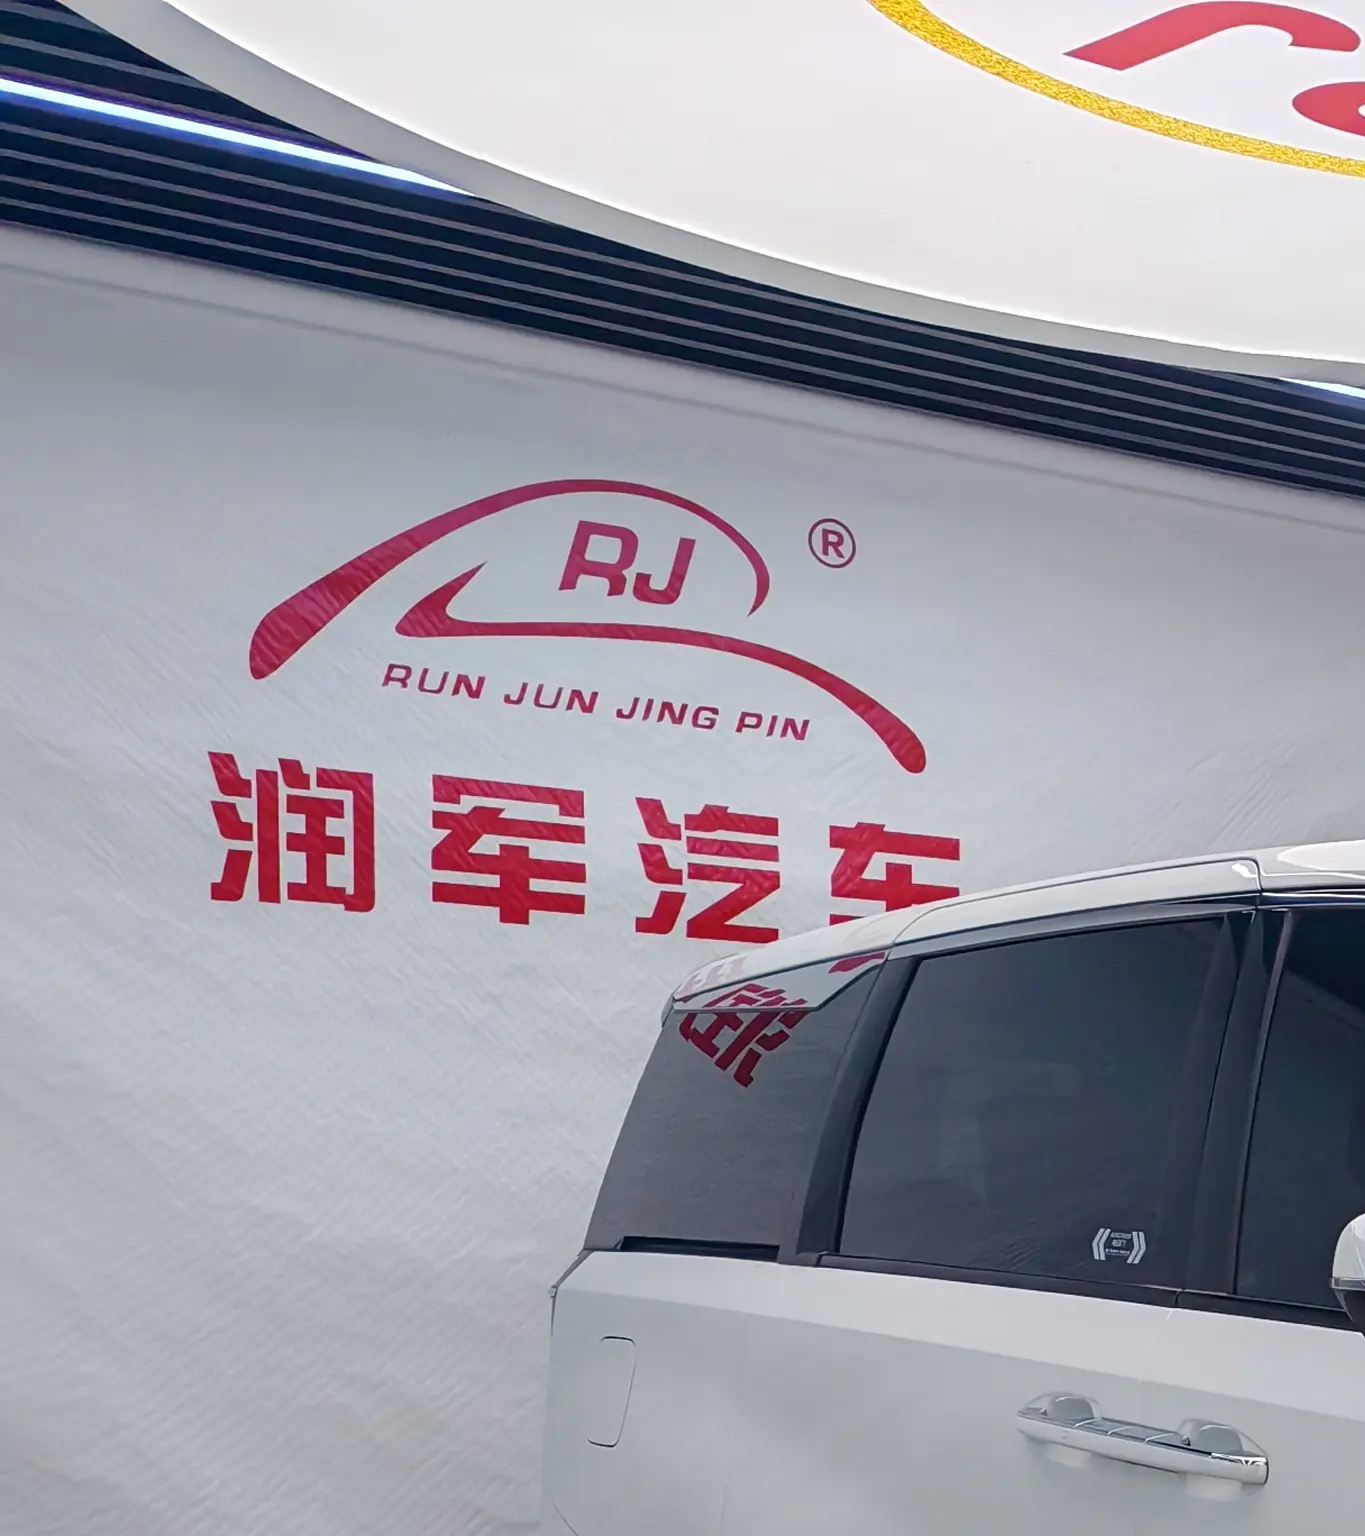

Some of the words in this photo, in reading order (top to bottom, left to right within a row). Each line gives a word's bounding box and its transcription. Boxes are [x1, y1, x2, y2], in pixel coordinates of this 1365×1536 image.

[558, 520, 696, 606] RJ
[382, 663, 486, 700] RUN
[503, 682, 599, 714] JUN
[616, 696, 719, 730] JING
[735, 711, 810, 742] PIN
[207, 751, 962, 945] 润军汽车
